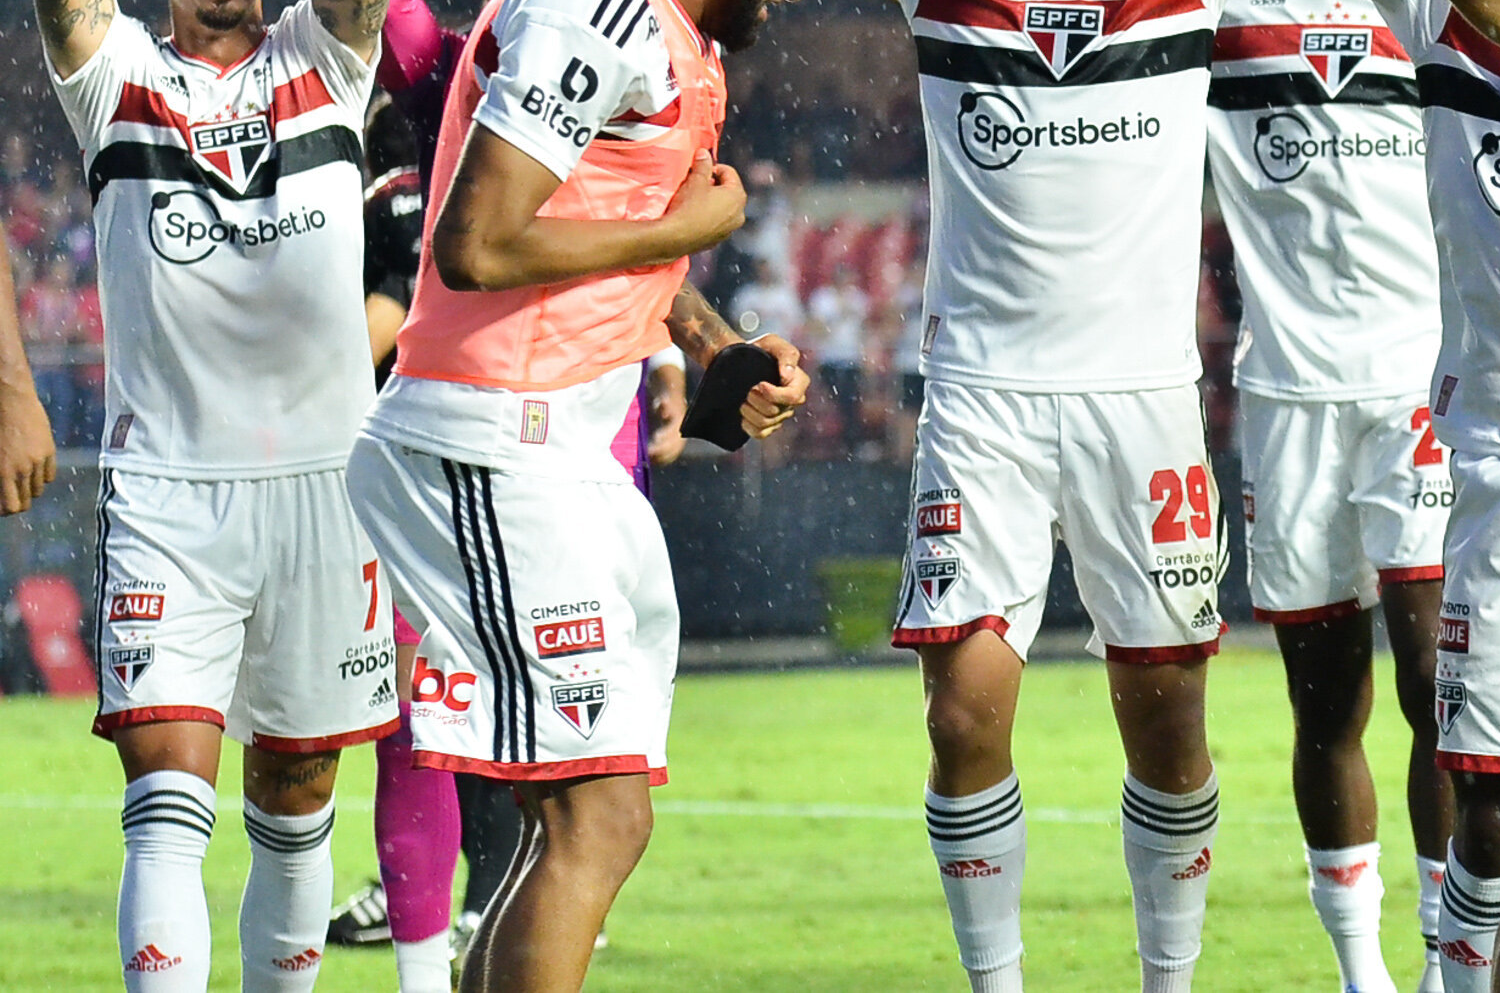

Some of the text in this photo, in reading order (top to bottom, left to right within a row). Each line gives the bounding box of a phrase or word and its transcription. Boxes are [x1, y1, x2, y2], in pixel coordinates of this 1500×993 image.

[1029, 9, 1098, 29] SPFC
[1304, 34, 1367, 51] SPFC
[521, 84, 592, 148] Bitso
[196, 122, 264, 149] SPFC
[973, 112, 1160, 153] Sportsbet.io
[165, 206, 325, 247] Sportsbet.io
[1411, 406, 1443, 467] 2
[1149, 465, 1211, 544] 29
[917, 505, 958, 529] CAUÊ
[920, 563, 955, 577] SPFC
[1156, 552, 1201, 566] Cartão
[1149, 565, 1214, 589] TODO
[362, 558, 378, 632] 7
[531, 600, 600, 620] CIMENTO
[538, 619, 602, 649] CAUÊ
[113, 648, 149, 664] SPFC
[556, 688, 604, 703] SPFC
[940, 863, 1002, 879] adidas
[125, 957, 183, 973] adidas
